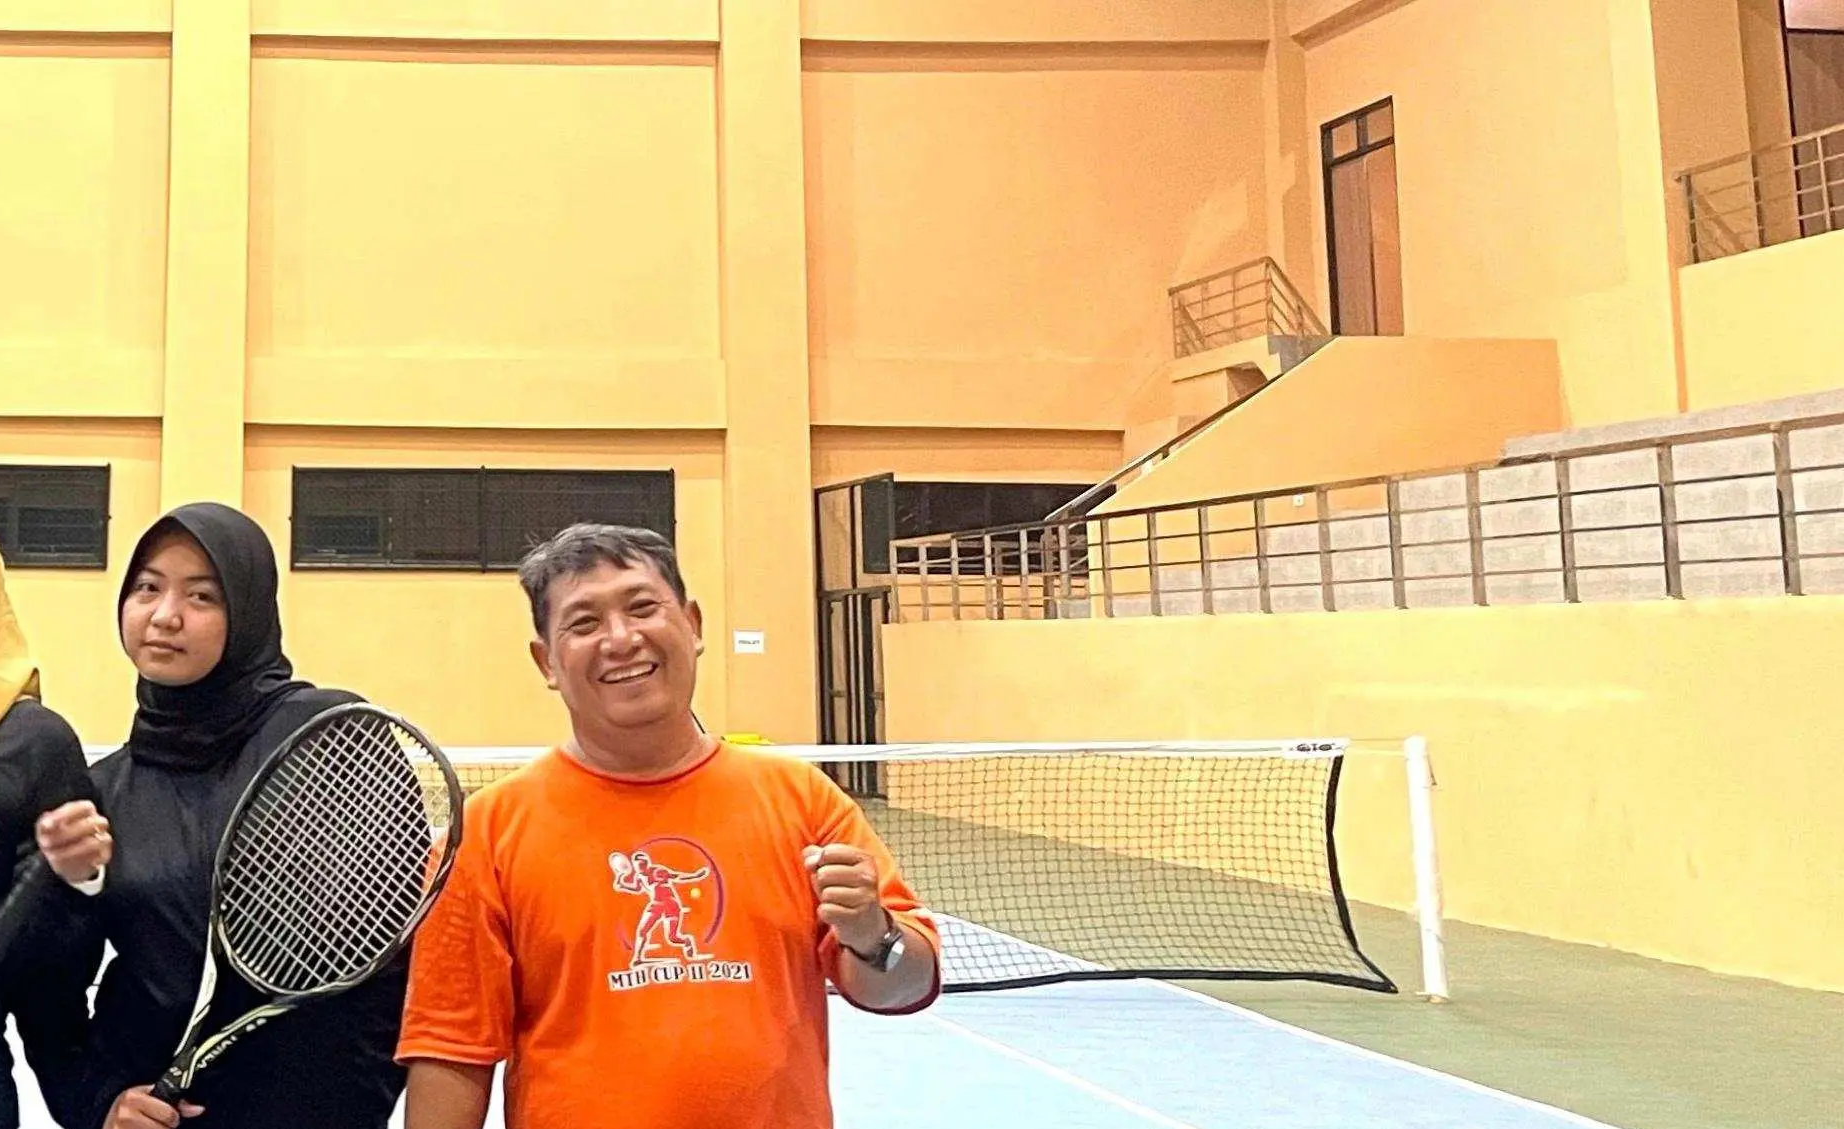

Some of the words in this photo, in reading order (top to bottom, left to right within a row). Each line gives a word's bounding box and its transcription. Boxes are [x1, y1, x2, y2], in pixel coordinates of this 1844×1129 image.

[610, 969, 647, 989] MTH
[653, 965, 685, 982] CUP
[709, 962, 751, 980] 2021
